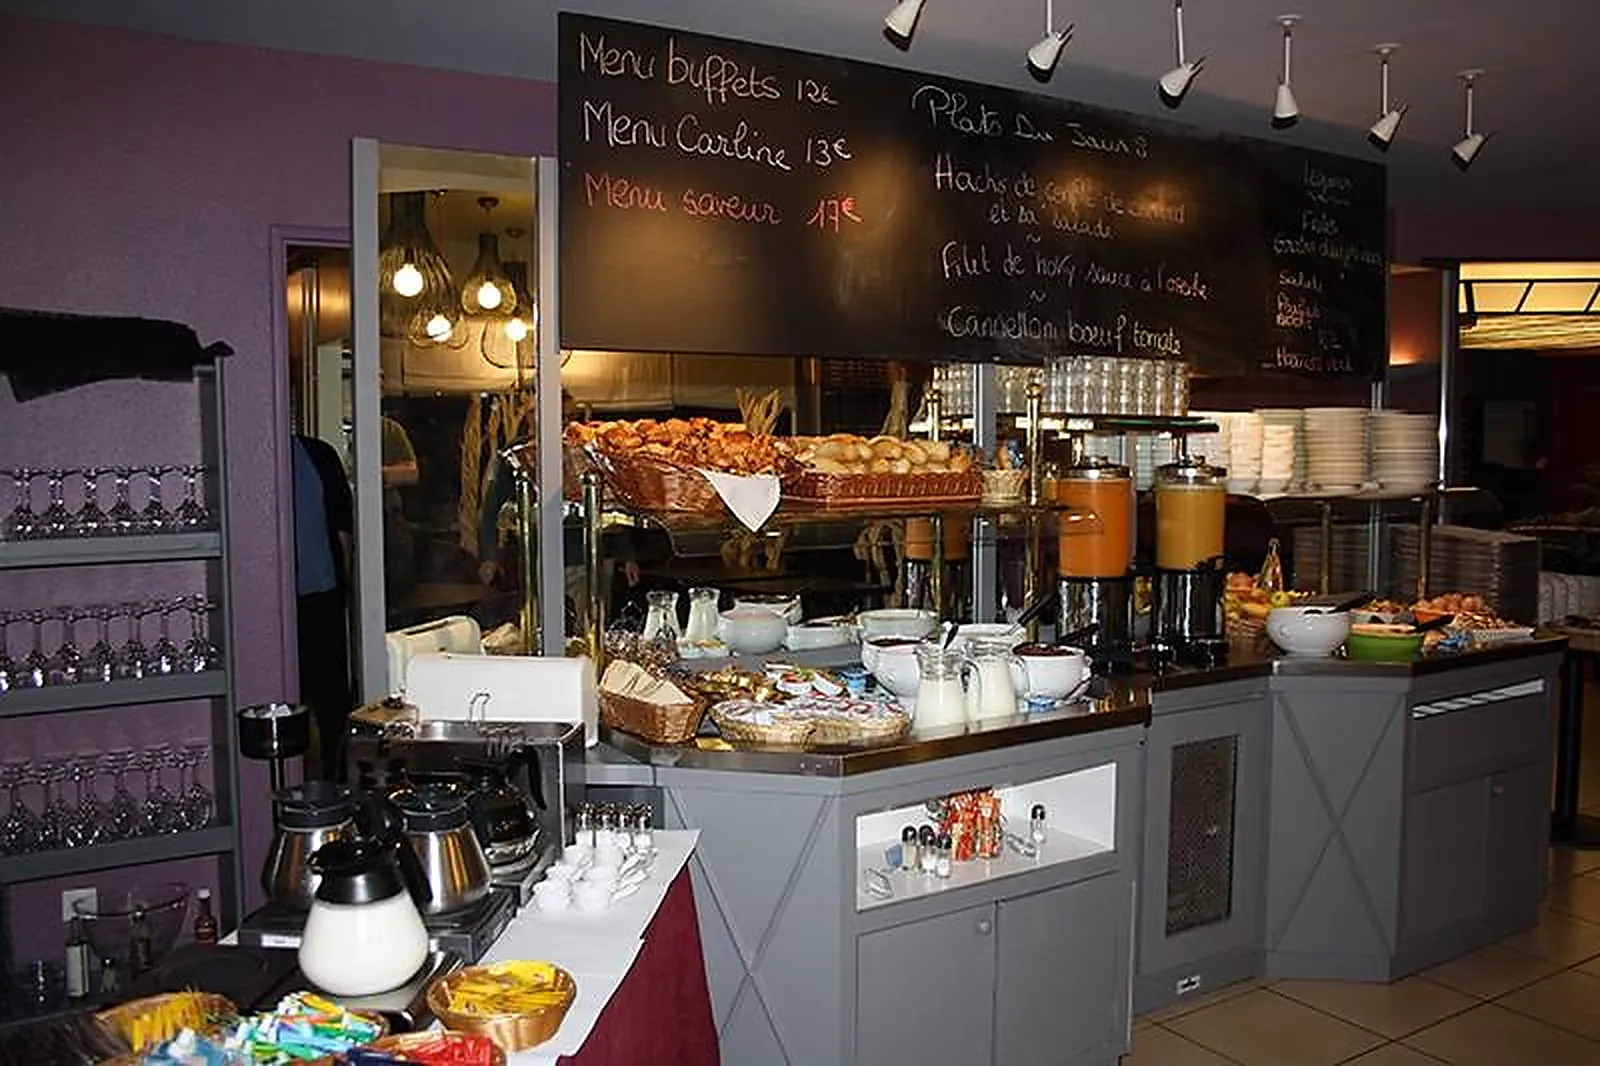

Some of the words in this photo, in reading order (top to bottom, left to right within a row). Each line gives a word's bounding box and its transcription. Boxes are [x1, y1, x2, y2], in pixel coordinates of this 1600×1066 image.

[579, 31, 656, 79] Menu
[667, 37, 781, 104] buffets
[582, 100, 667, 148] Menu
[676, 112, 793, 171] Carline
[804, 136, 853, 167] 13€
[583, 171, 668, 212] Menu
[681, 188, 782, 225] saveur
[806, 195, 863, 234] 17€
